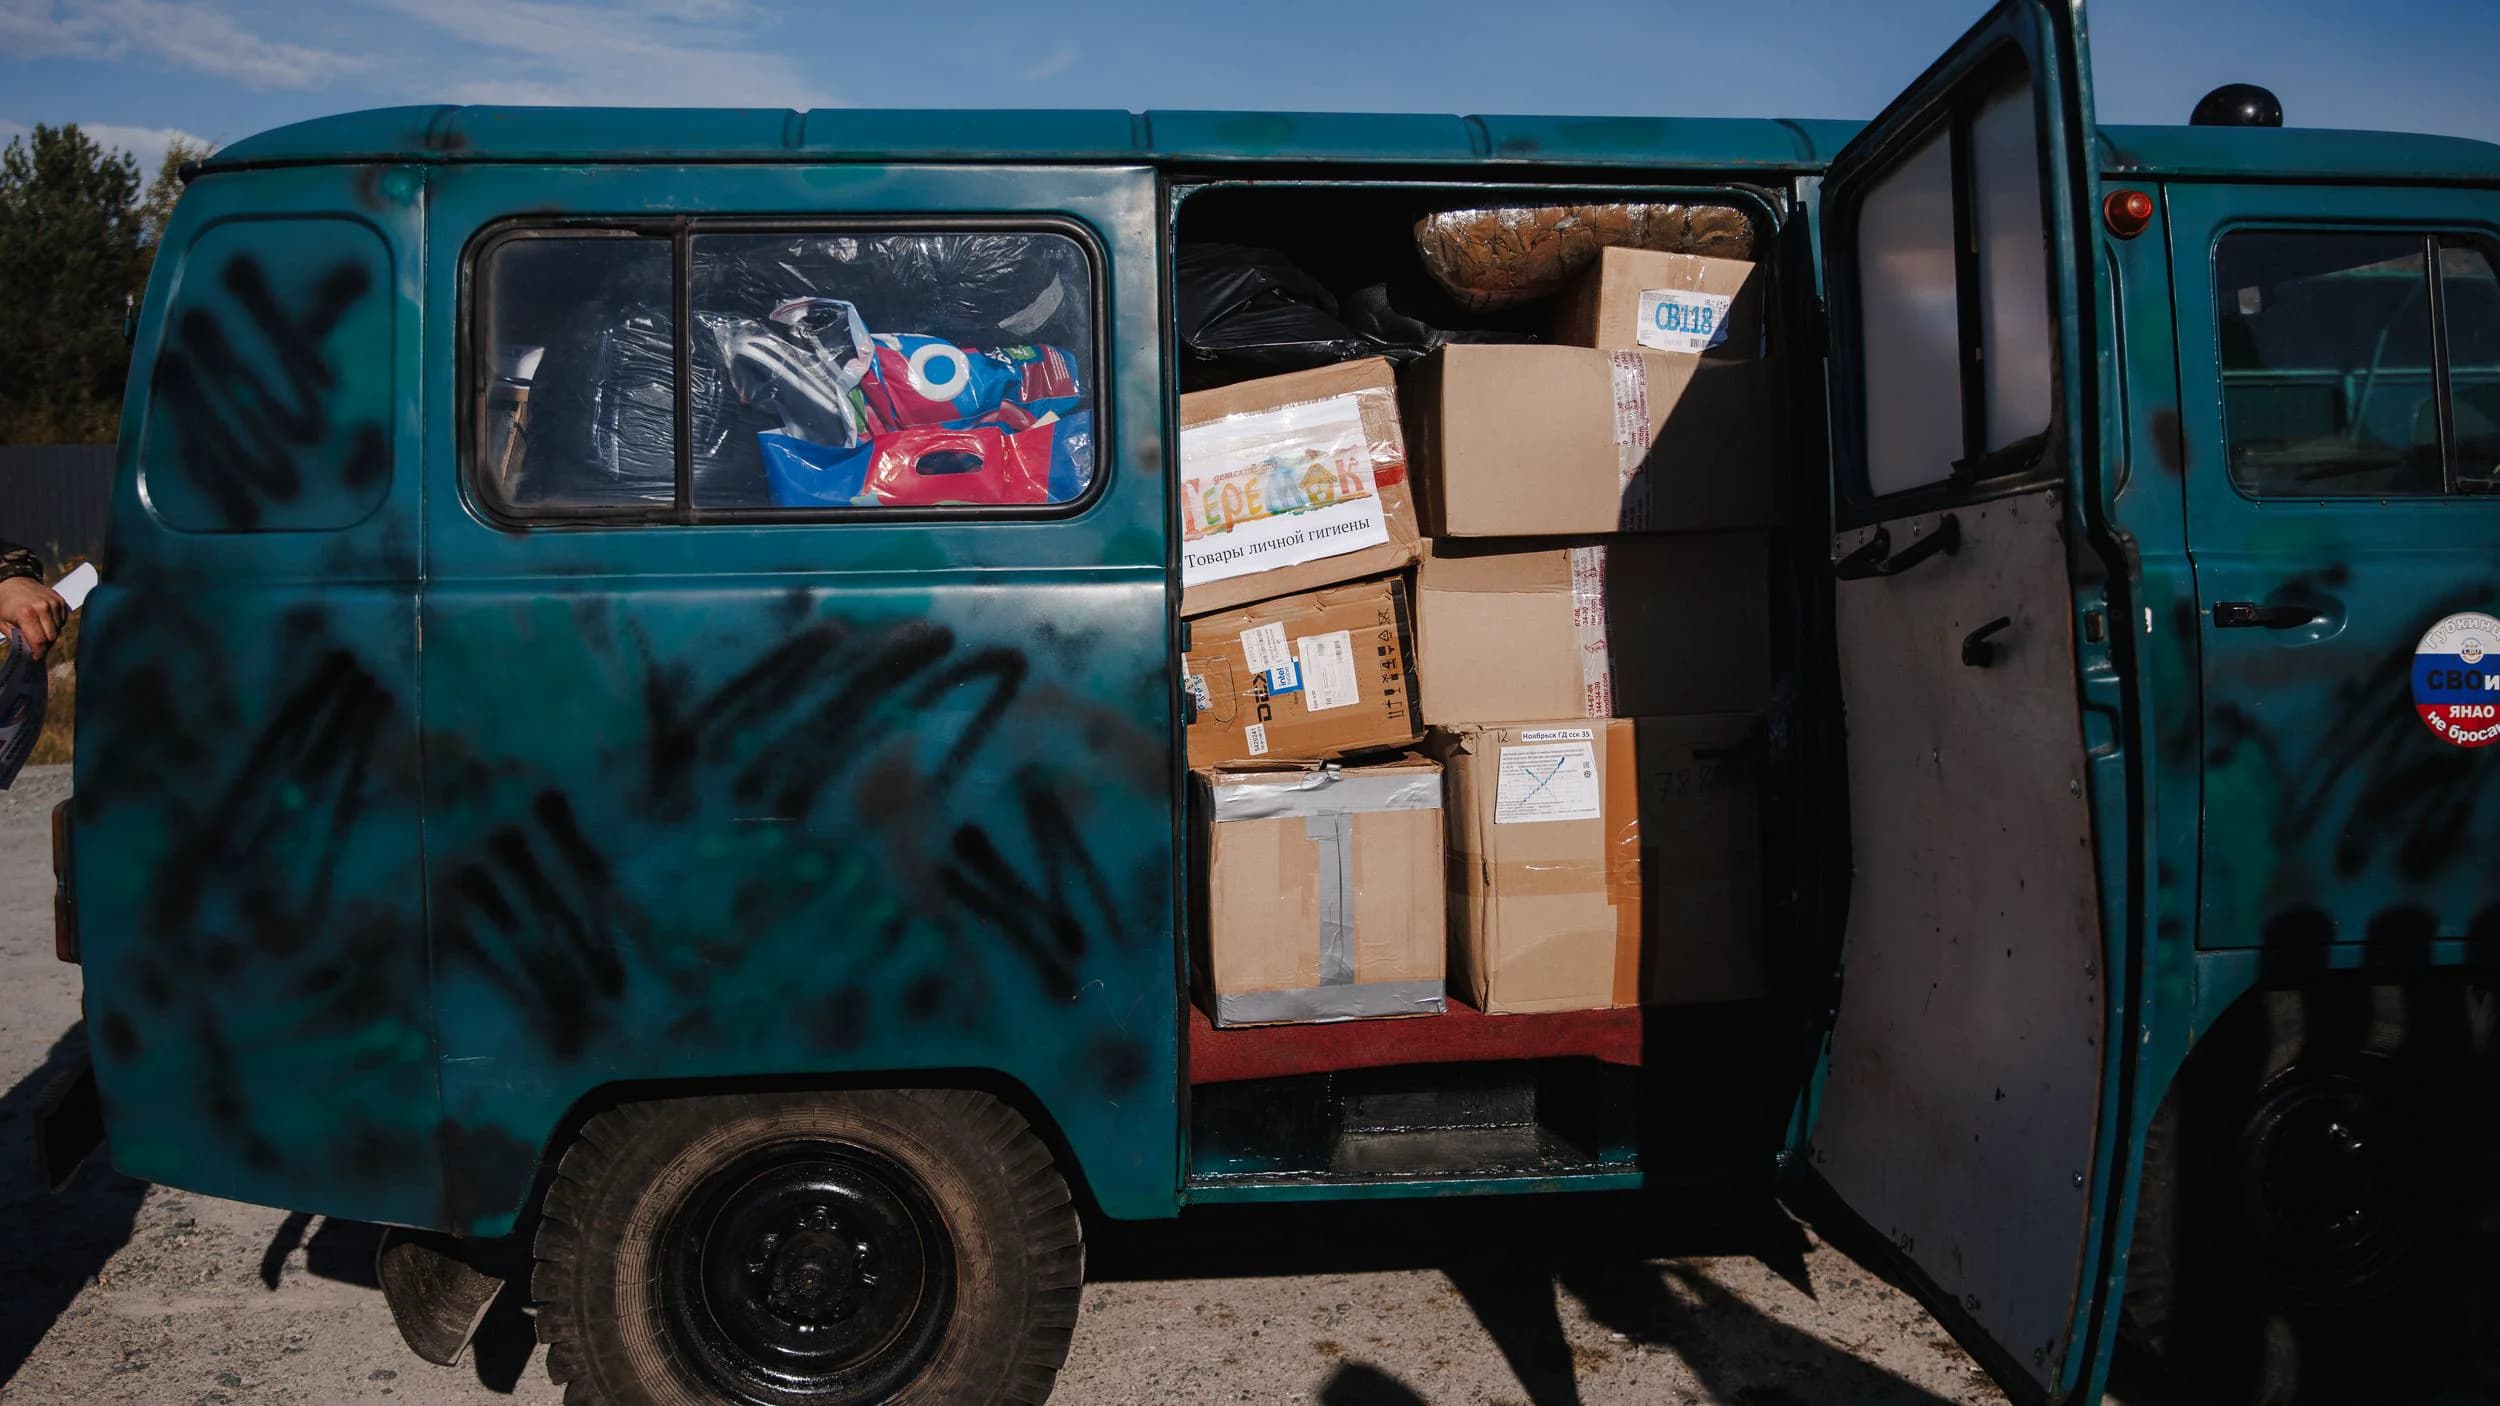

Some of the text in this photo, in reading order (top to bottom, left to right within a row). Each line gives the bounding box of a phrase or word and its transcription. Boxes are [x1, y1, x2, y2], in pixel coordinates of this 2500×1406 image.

[1184, 517, 1370, 569] Товары личной гигиены
[1276, 667, 1287, 687] intel
[2449, 705, 2495, 718] ЯНАО
[1523, 732, 1556, 740] Ноябрьск
[2427, 711, 2500, 744] не броса
